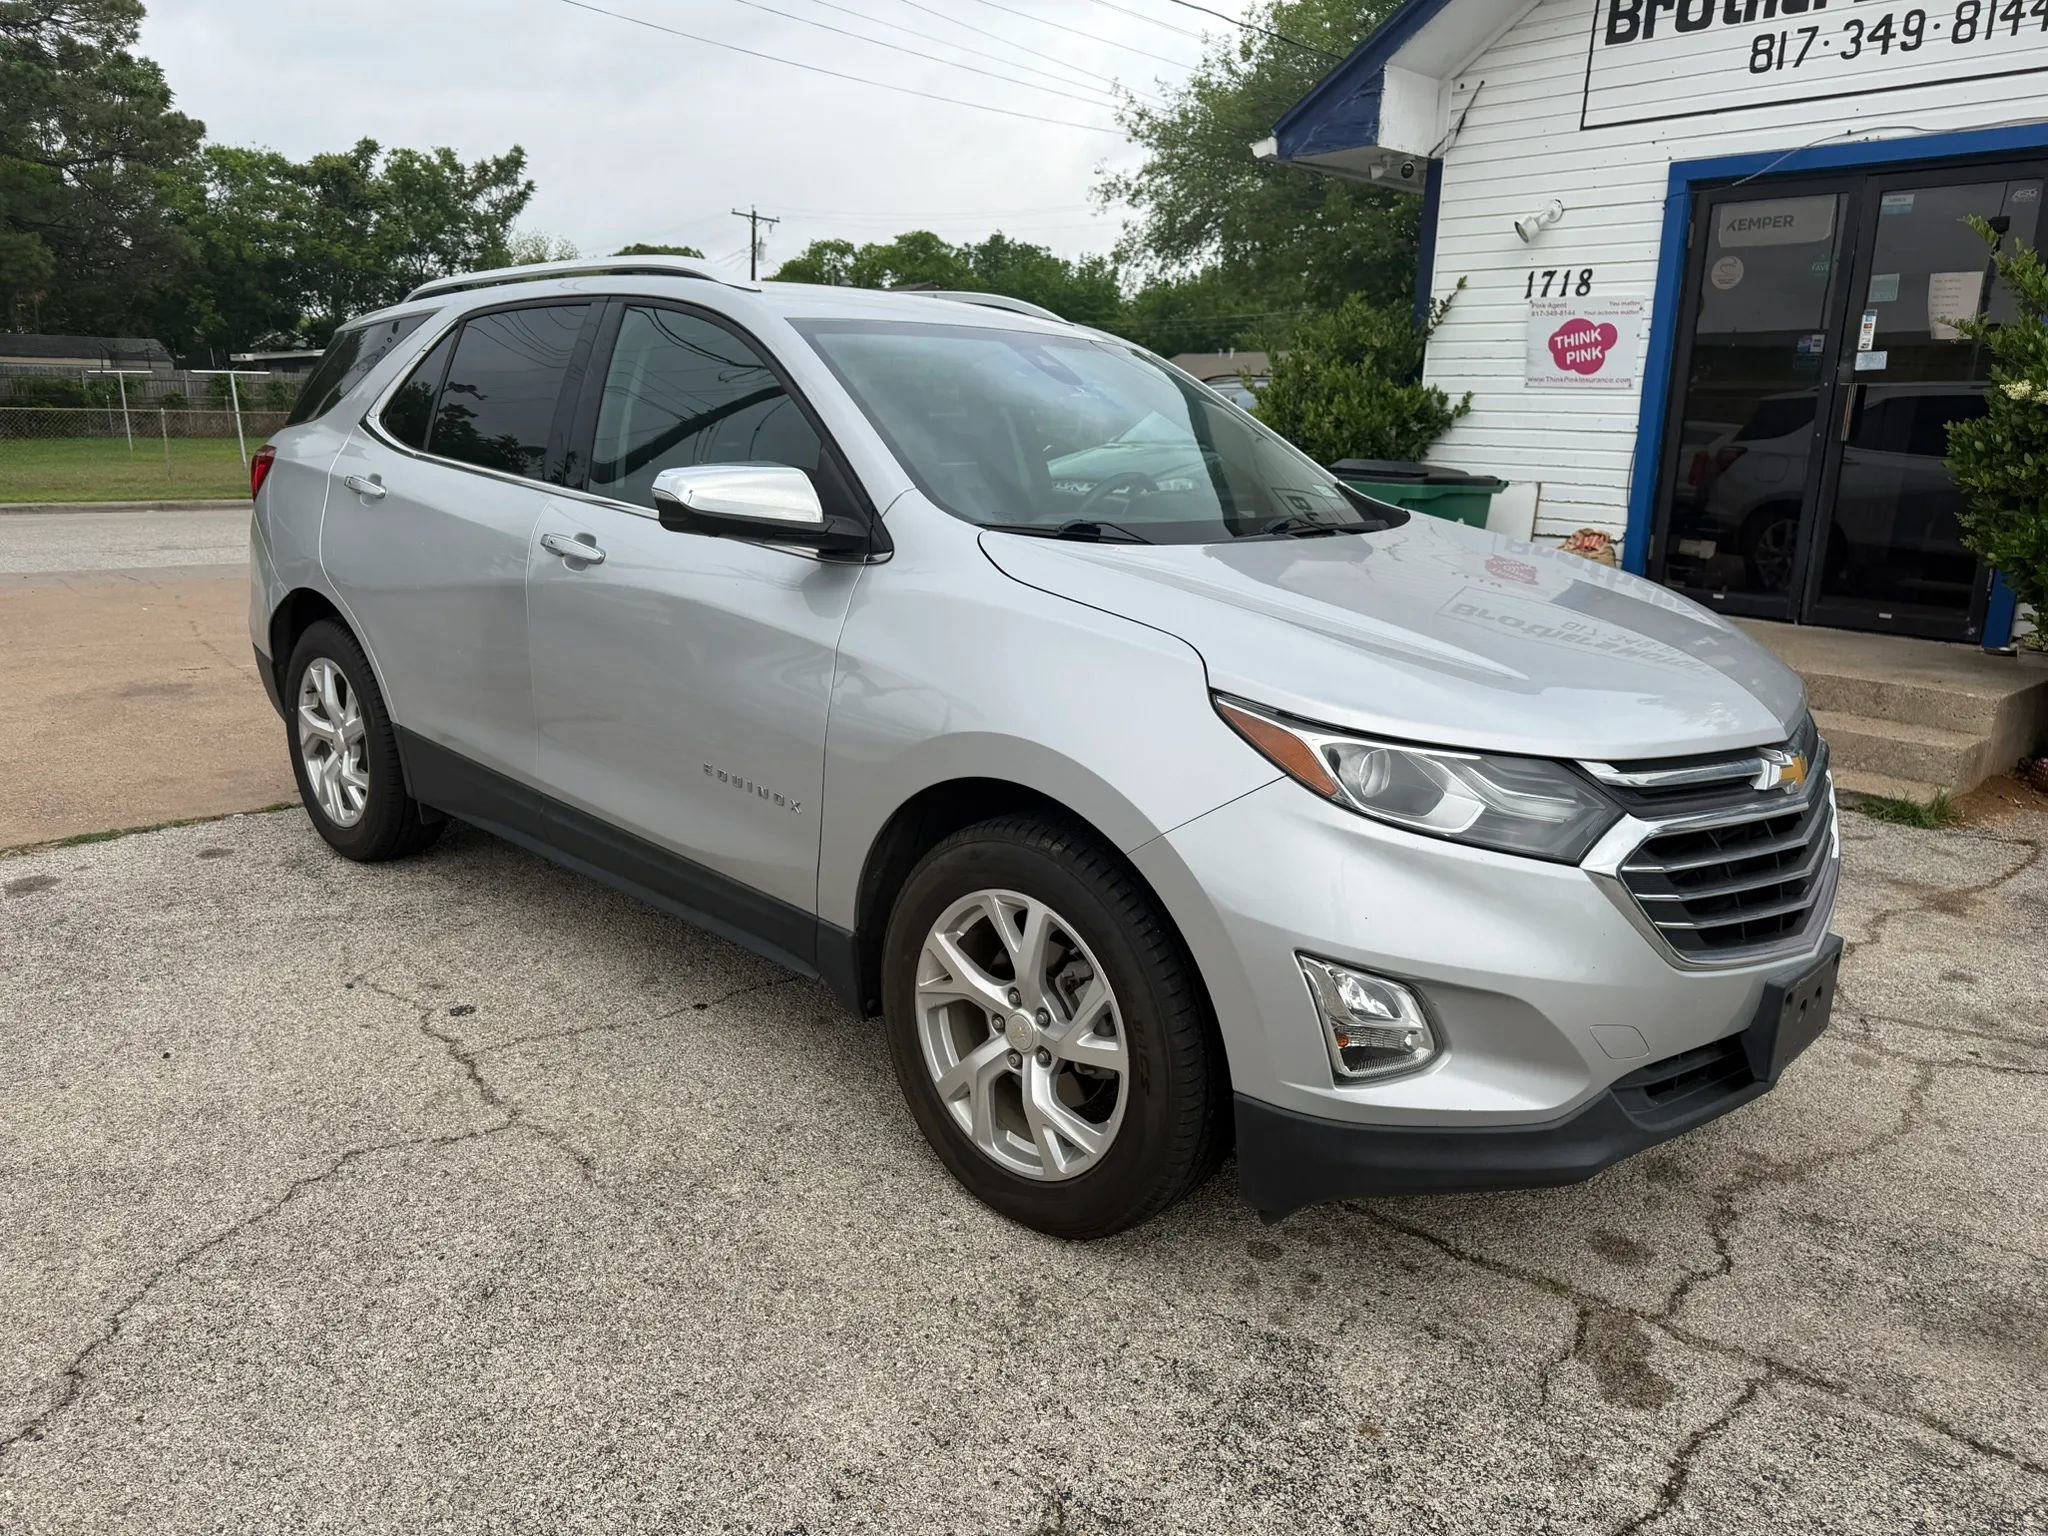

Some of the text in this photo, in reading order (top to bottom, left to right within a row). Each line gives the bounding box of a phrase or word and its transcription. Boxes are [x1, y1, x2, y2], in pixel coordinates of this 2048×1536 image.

[1726, 215, 1795, 232] KEMPER
[1524, 268, 1593, 299] 1718
[1554, 328, 1602, 349] THINK
[1566, 345, 1603, 365] PINK
[703, 762, 802, 814] EQUINOX
